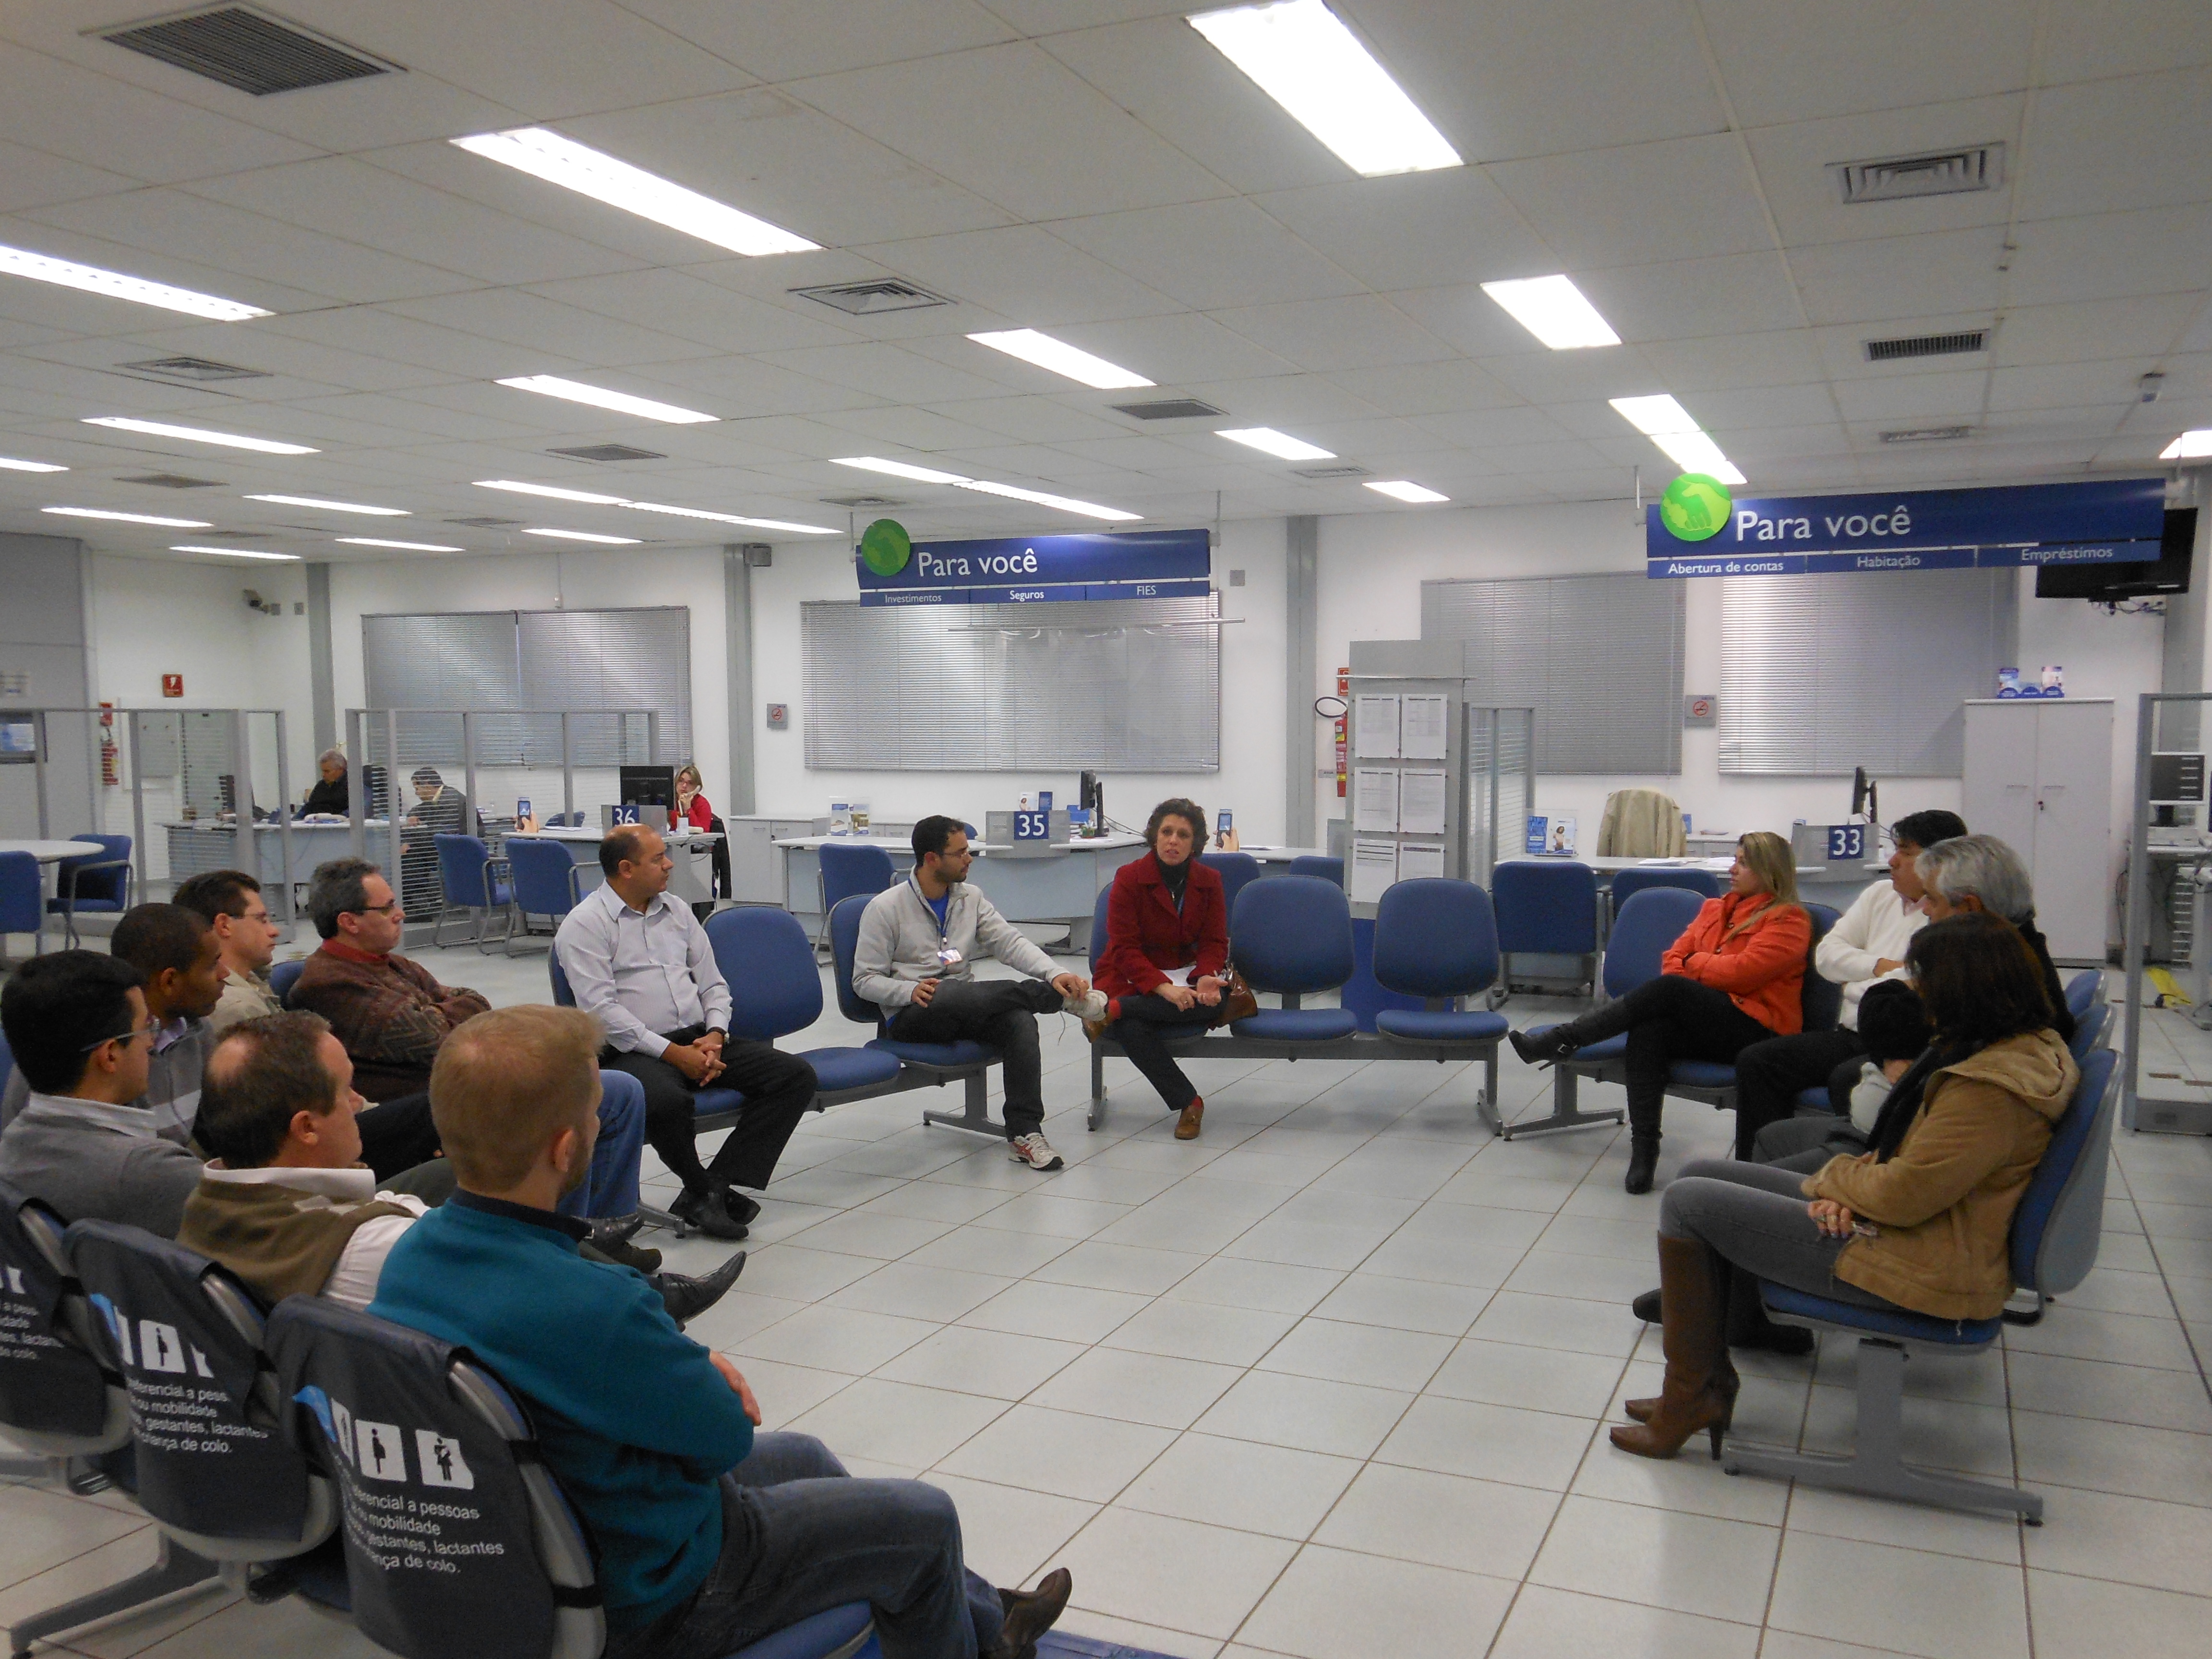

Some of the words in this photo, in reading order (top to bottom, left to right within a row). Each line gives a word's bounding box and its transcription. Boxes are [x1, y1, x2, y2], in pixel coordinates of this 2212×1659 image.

[1737, 511, 1813, 541] Para
[1825, 505, 1911, 537] você
[918, 552, 971, 577] Para
[977, 548, 1038, 574] você
[1668, 564, 1722, 574] Abertura
[1726, 562, 1742, 572] de
[1744, 562, 1784, 571] contas
[1857, 556, 1921, 568] Habitação
[1010, 590, 1045, 601] Seguros
[1136, 585, 1157, 596] FIES
[885, 595, 942, 603] Investimentos
[615, 808, 636, 825] 36
[1018, 814, 1045, 836] 35
[1833, 829, 1860, 855] 33
[186, 1389, 194, 1399] a
[151, 1402, 217, 1418] mobilidade
[180, 1437, 198, 1451] de
[201, 1439, 233, 1453] colo.
[407, 1500, 417, 1512] a
[420, 1503, 480, 1520] pessoas
[368, 1513, 441, 1536] mobilidade
[433, 1540, 505, 1555] lactantes
[404, 1554, 423, 1568] de
[426, 1559, 461, 1574] colo.
